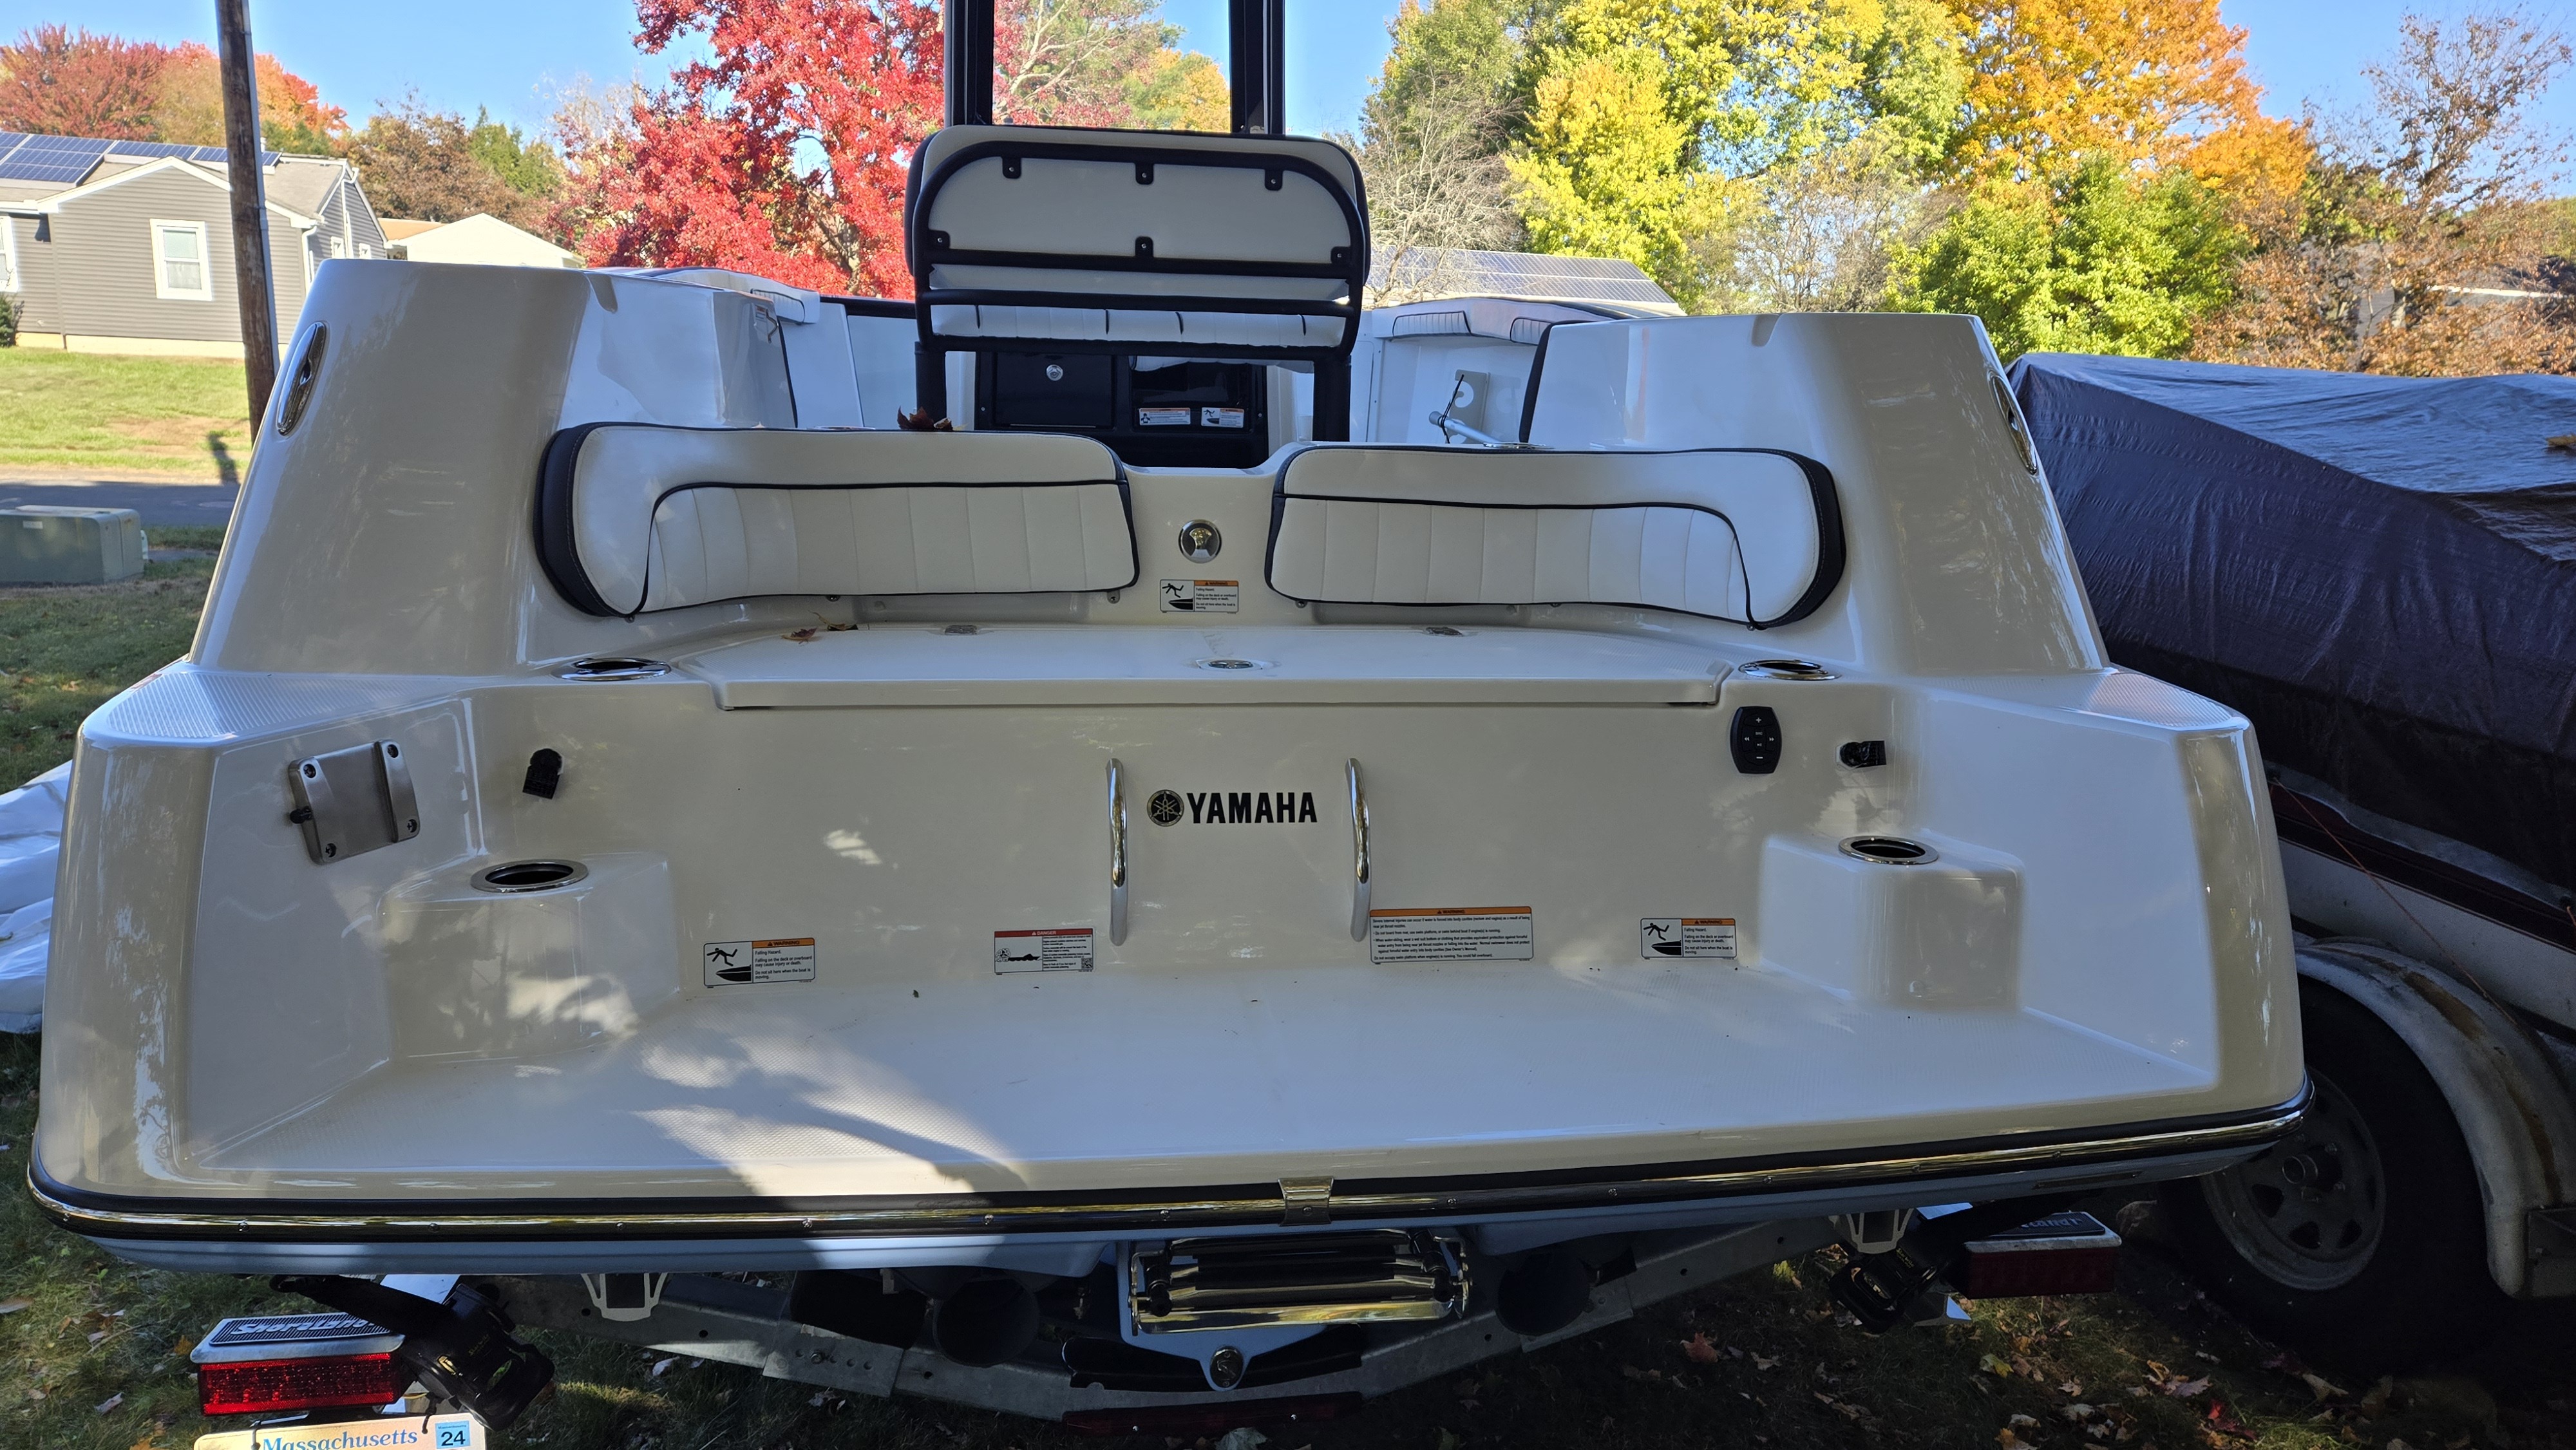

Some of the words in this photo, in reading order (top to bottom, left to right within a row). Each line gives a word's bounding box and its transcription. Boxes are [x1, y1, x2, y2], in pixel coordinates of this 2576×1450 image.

[1186, 792, 1317, 823] YAMAHA
[263, 1429, 418, 1450] Massachusetts
[441, 1430, 466, 1447] 24
